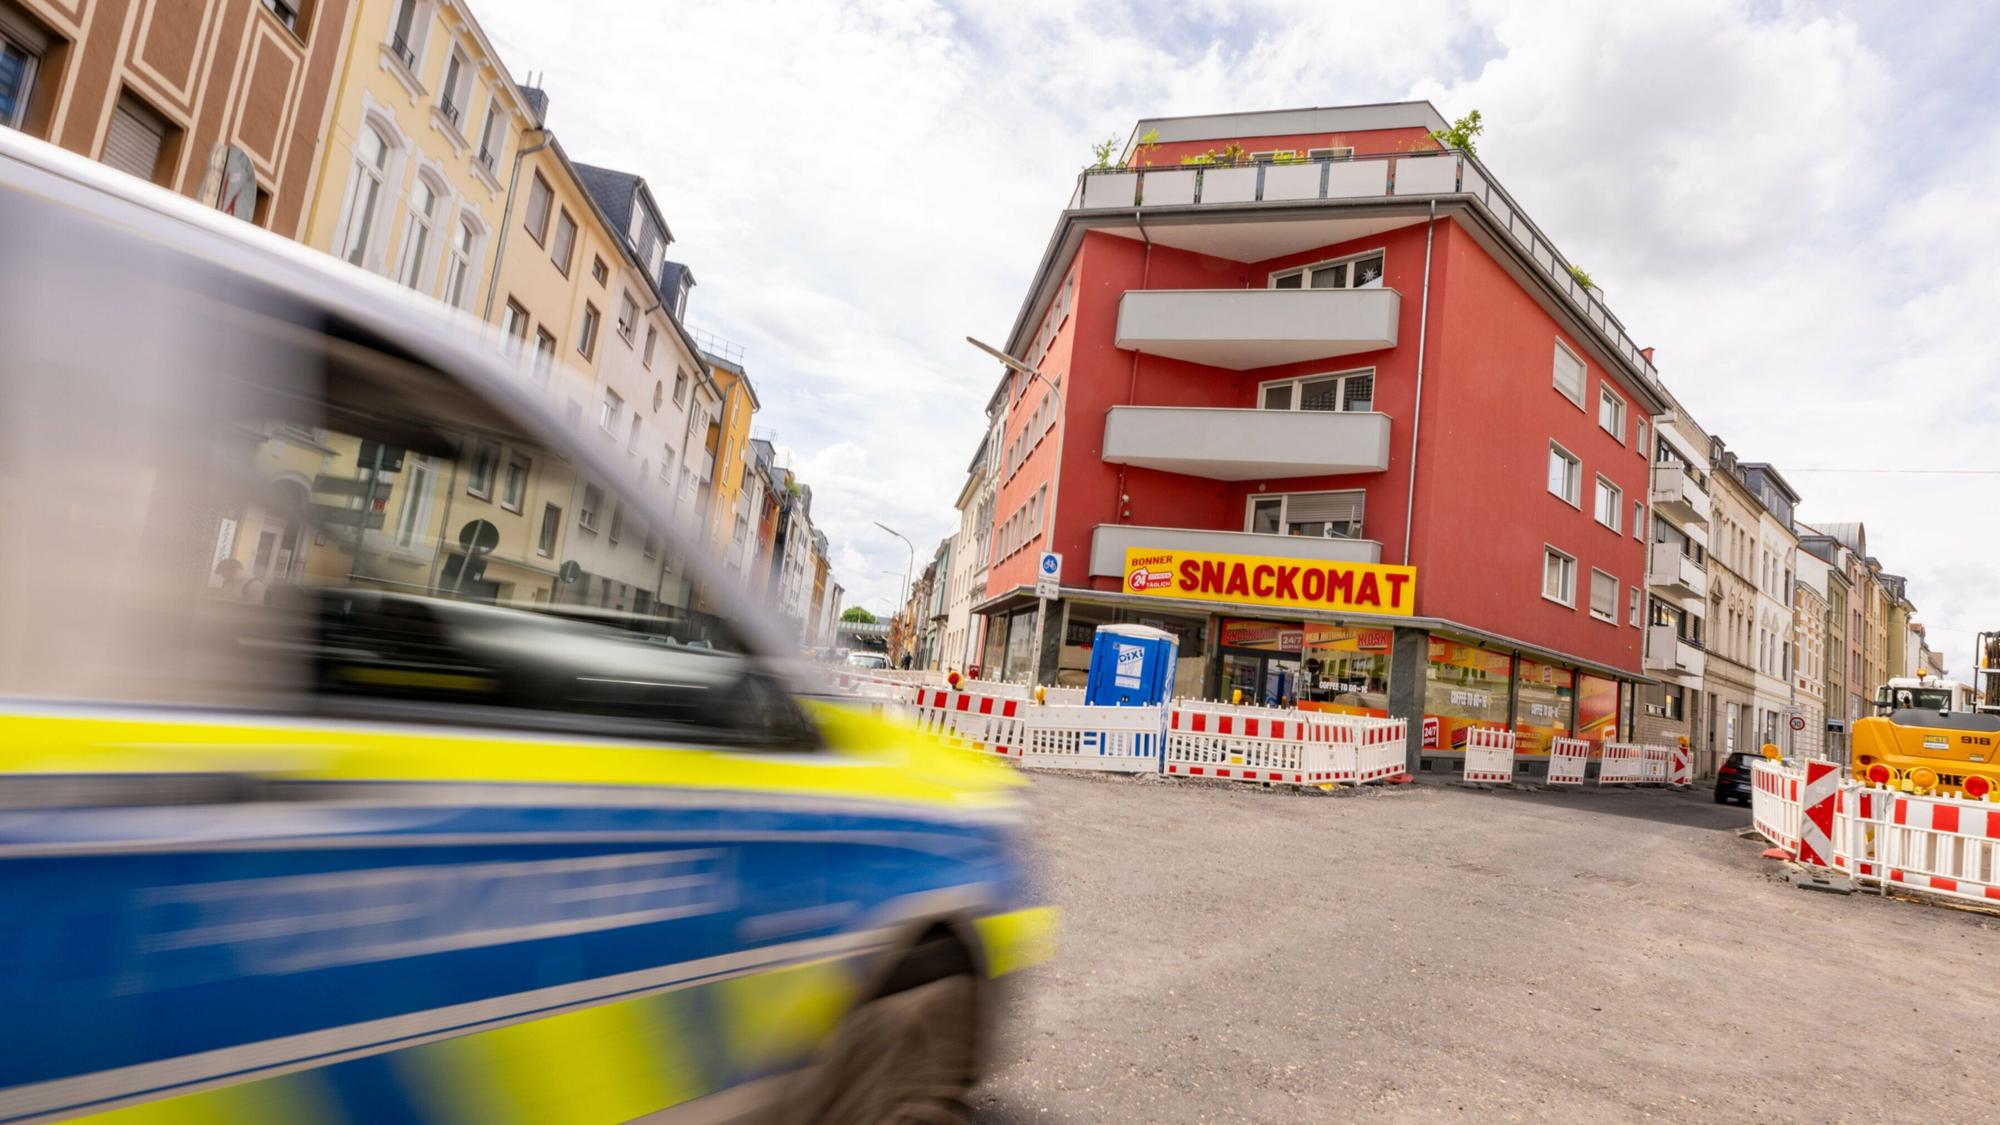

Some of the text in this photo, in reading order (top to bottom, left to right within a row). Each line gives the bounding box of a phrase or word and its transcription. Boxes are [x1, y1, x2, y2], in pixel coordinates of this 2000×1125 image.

[1131, 555, 1173, 567] BONNER
[1133, 573, 1147, 587] 24
[1179, 559, 1410, 608] SNACKOMAT
[1282, 636, 1302, 645] 24/7
[1358, 632, 1387, 646] KIOSK
[1340, 683, 1348, 692] TO
[1961, 736, 1991, 746] 918
